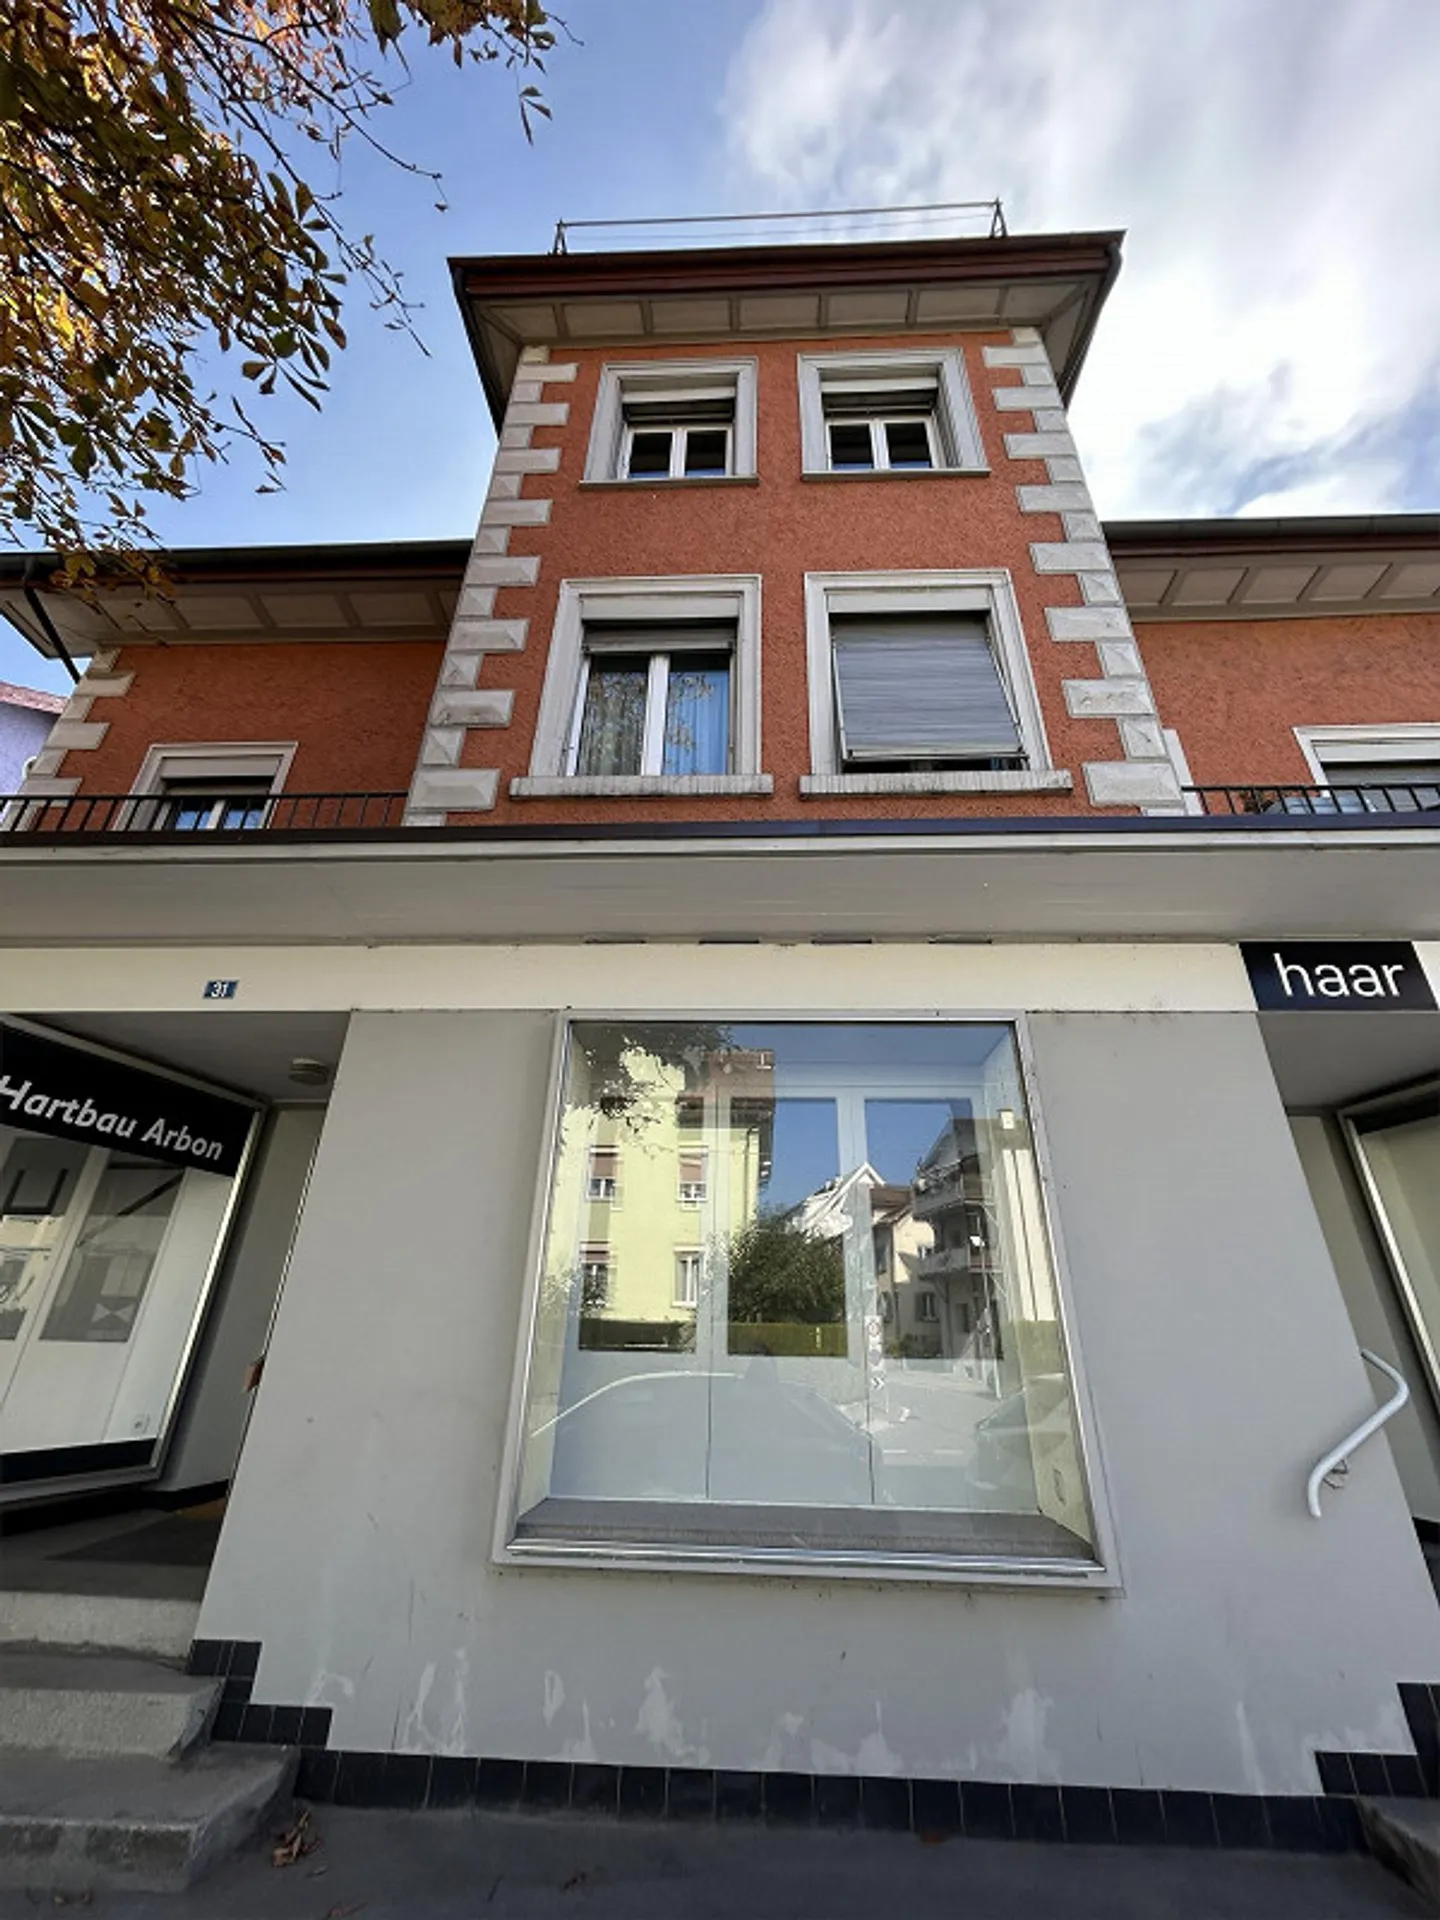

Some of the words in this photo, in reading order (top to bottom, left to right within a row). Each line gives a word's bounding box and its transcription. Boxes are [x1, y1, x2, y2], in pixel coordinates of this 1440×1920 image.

[211, 981, 228, 998] 31
[1273, 952, 1405, 997] haar
[0, 1075, 138, 1138] Hartbau
[140, 1117, 224, 1161] Arbon
